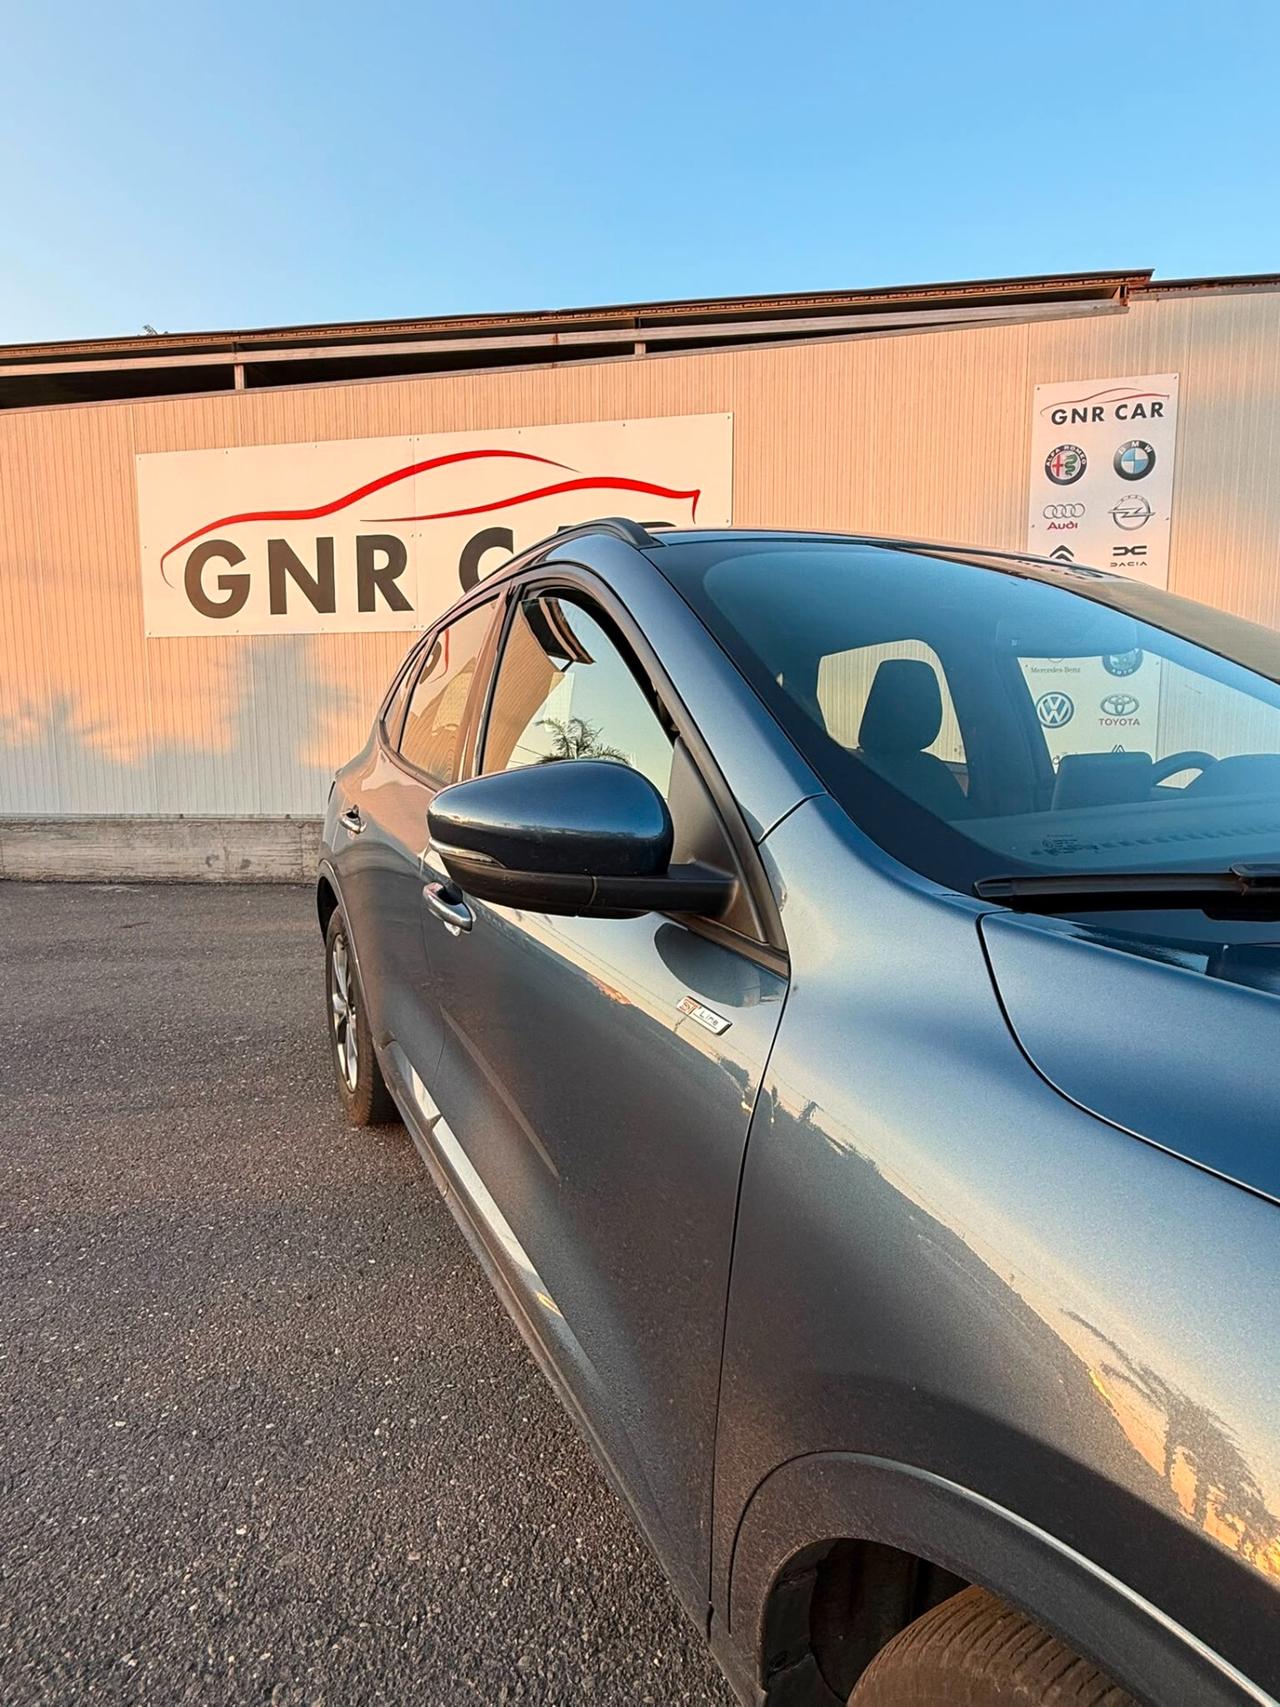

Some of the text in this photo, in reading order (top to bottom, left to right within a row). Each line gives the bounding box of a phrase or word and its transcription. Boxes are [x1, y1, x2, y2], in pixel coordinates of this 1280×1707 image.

[1051, 402, 1164, 425] GNR CAR
[1047, 522, 1078, 530] Audi
[184, 534, 414, 619] GNR
[1099, 718, 1140, 726] TOYOTA
